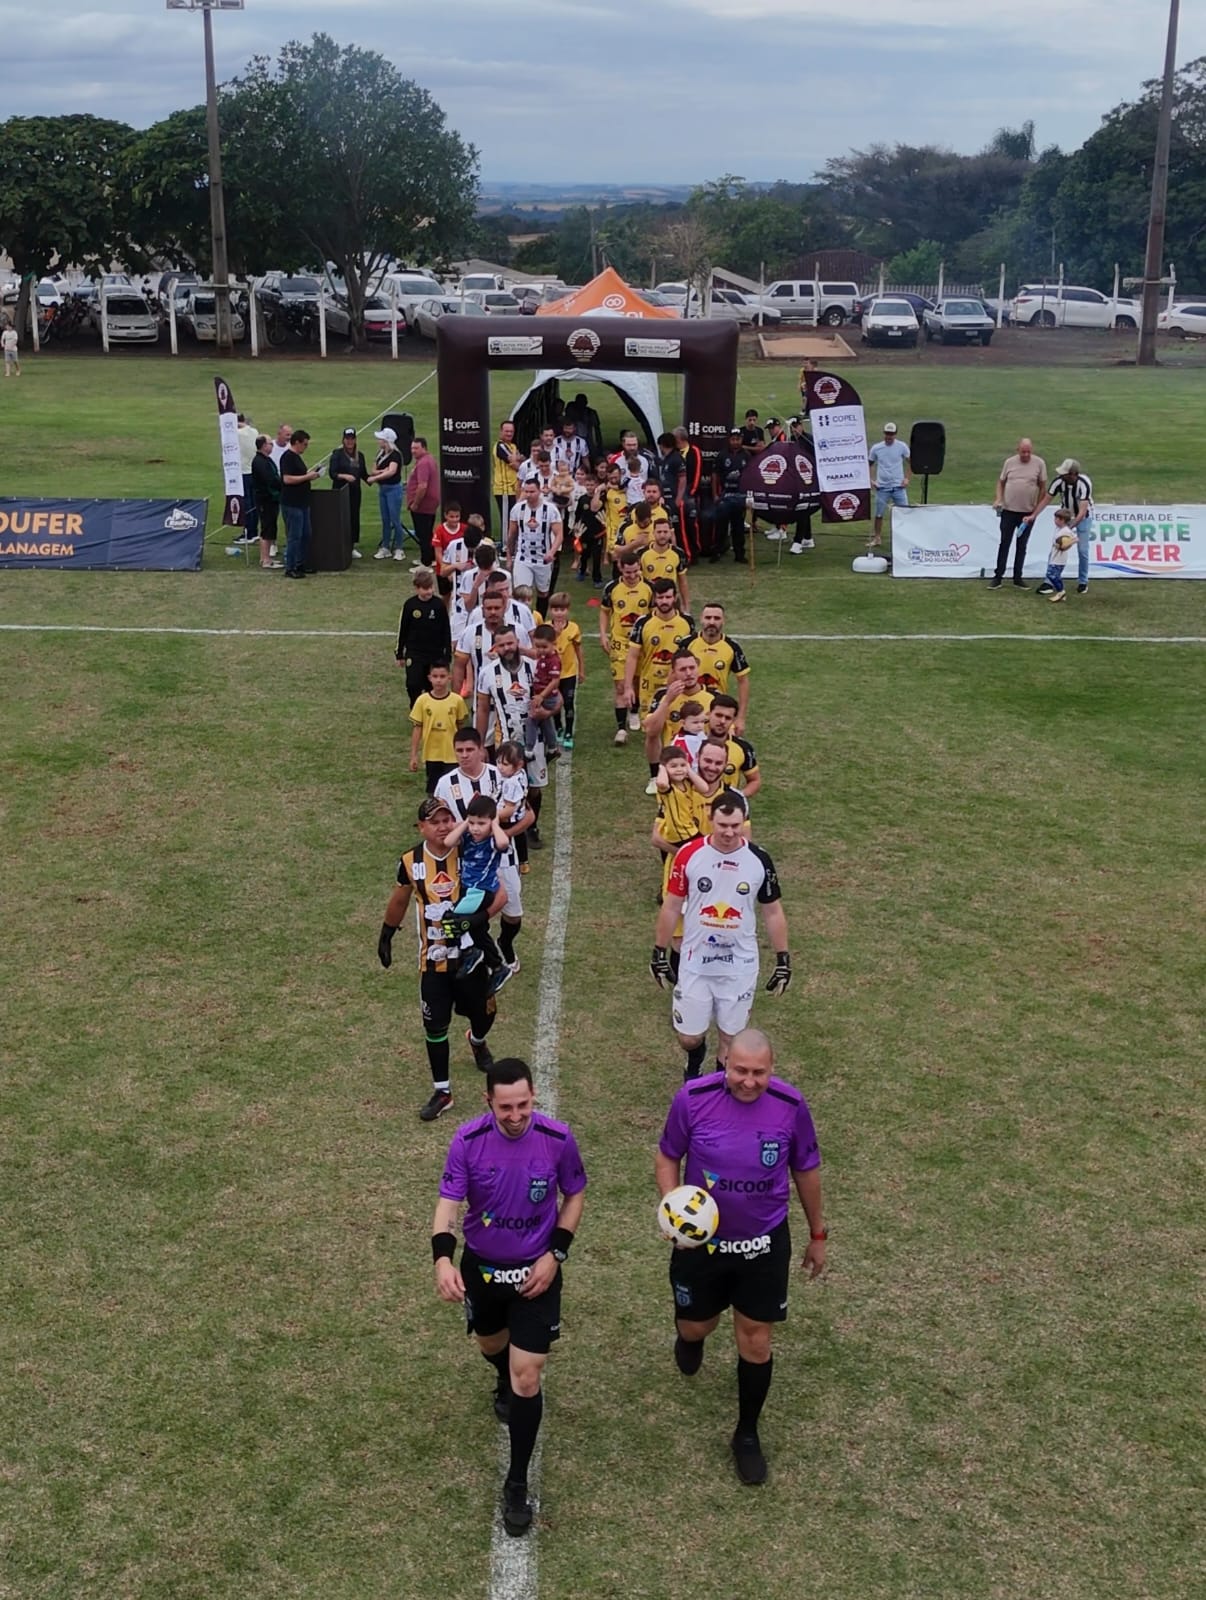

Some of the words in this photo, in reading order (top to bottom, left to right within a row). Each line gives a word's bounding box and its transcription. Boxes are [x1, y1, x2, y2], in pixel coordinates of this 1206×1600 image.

[833, 414, 857, 422] COPEL
[455, 421, 480, 429] COPEL
[702, 425, 727, 433] COPEL
[444, 469, 473, 477] PARANÁ
[1095, 513, 1155, 521] ECRETARIA
[1158, 513, 1173, 521] DE
[1096, 544, 1182, 562] LAZER
[611, 640, 621, 650] 33
[540, 768, 546, 780] 3
[494, 1267, 531, 1284] SICOO
